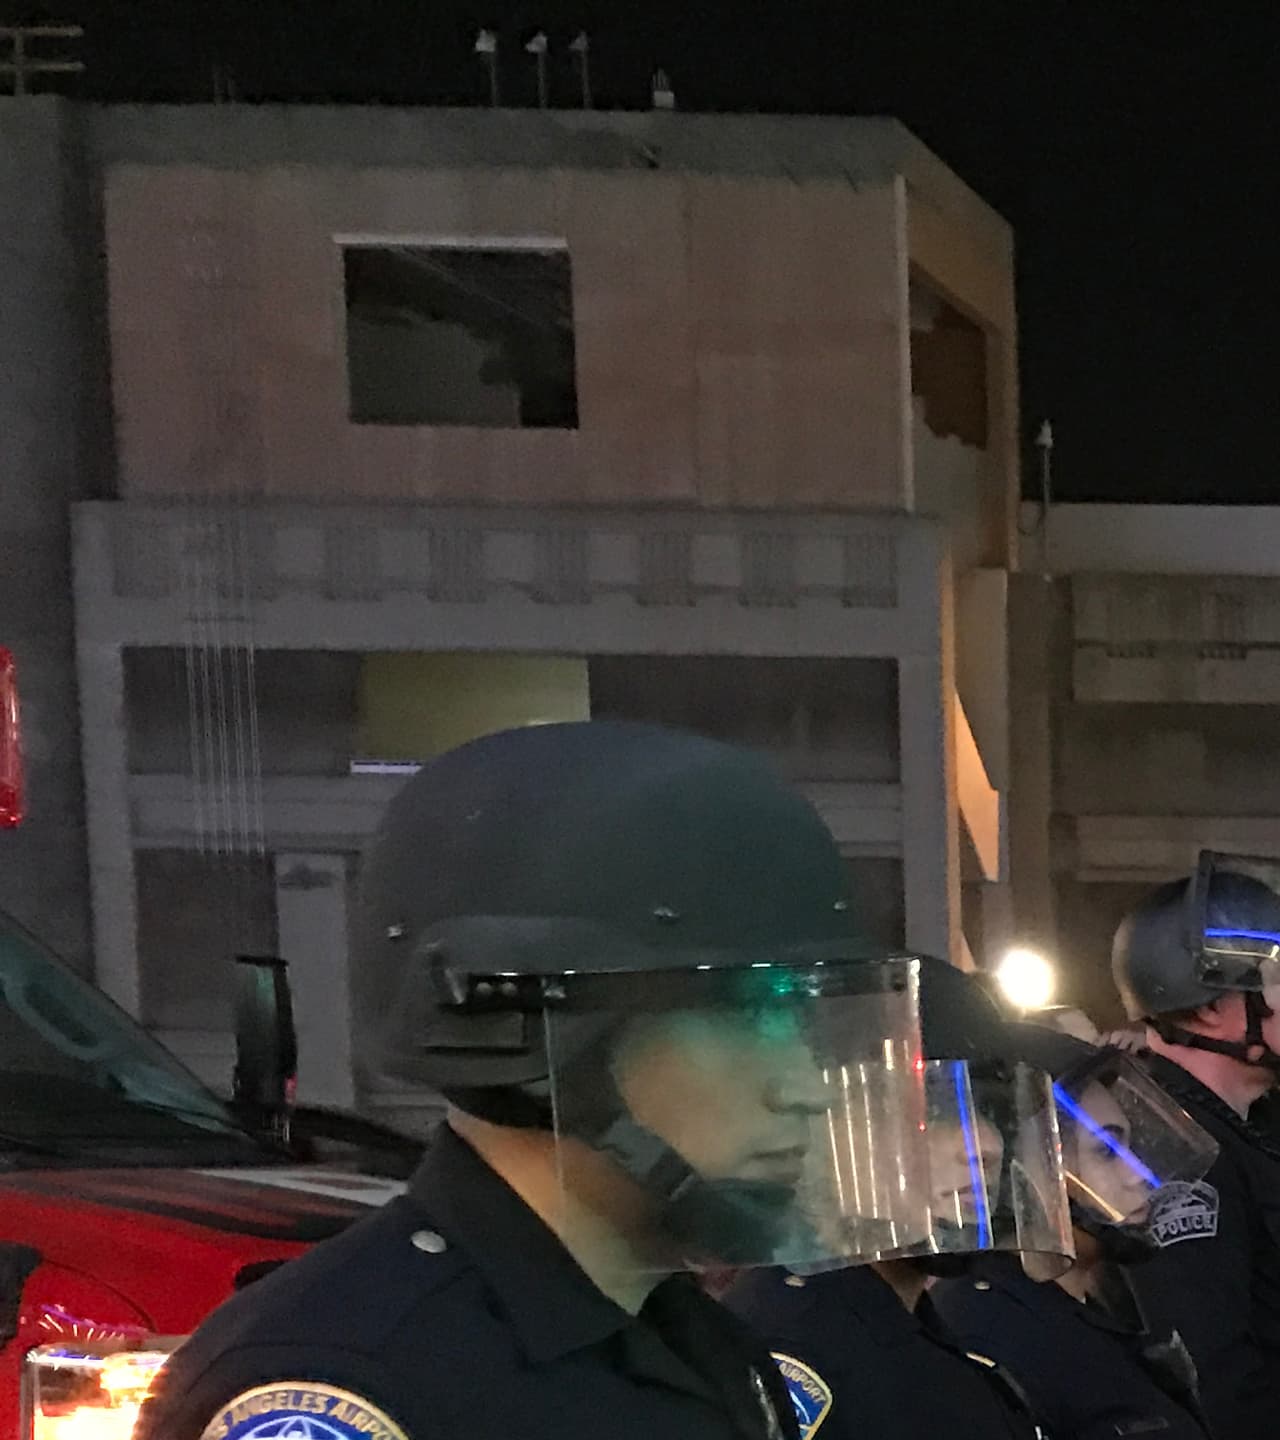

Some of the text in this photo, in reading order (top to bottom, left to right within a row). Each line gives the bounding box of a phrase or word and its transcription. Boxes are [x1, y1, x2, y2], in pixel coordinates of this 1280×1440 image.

[1158, 1215, 1213, 1239] POLICE
[779, 1362, 826, 1403] AIRPORT
[231, 1390, 328, 1423] ANGELES
